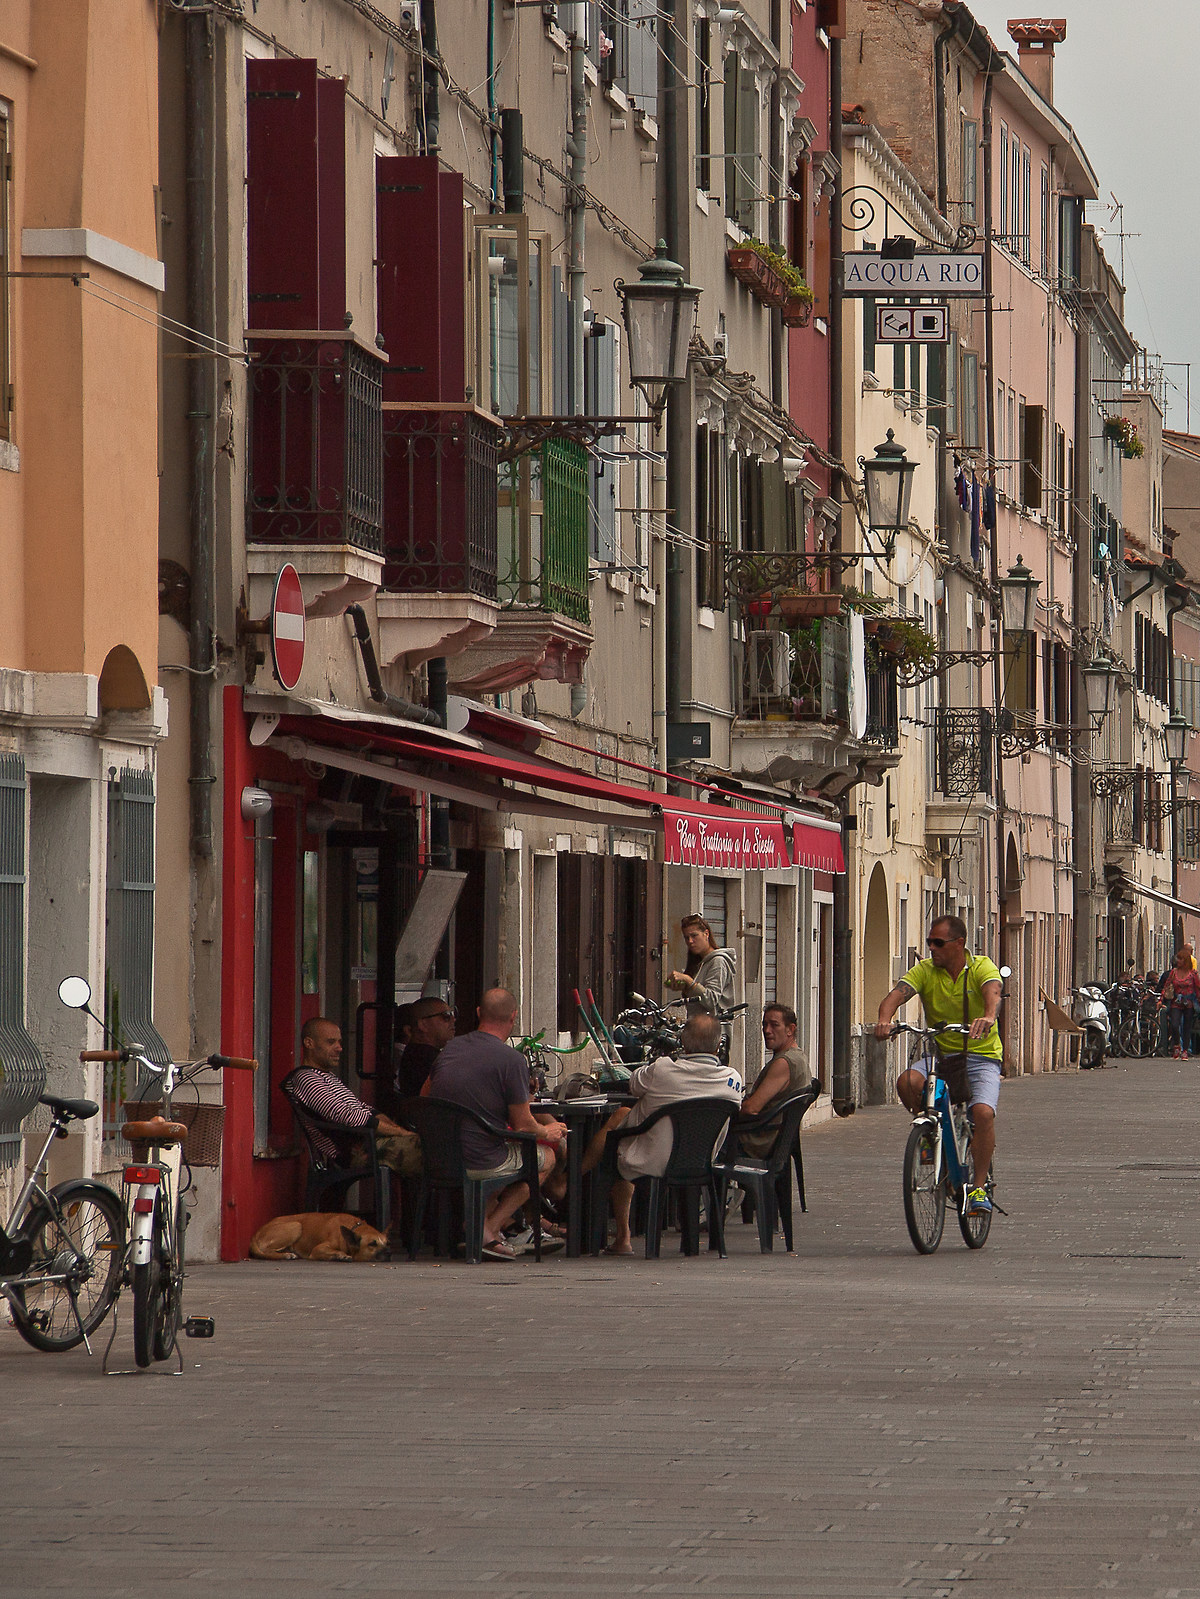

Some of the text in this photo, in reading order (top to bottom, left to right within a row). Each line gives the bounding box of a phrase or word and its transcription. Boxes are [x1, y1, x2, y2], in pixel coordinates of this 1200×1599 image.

[847, 262, 979, 287] ACQUA RIO
[676, 818, 697, 849] Bar
[698, 821, 734, 853] Trattoria
[734, 838, 741, 853] a
[742, 826, 751, 854] la
